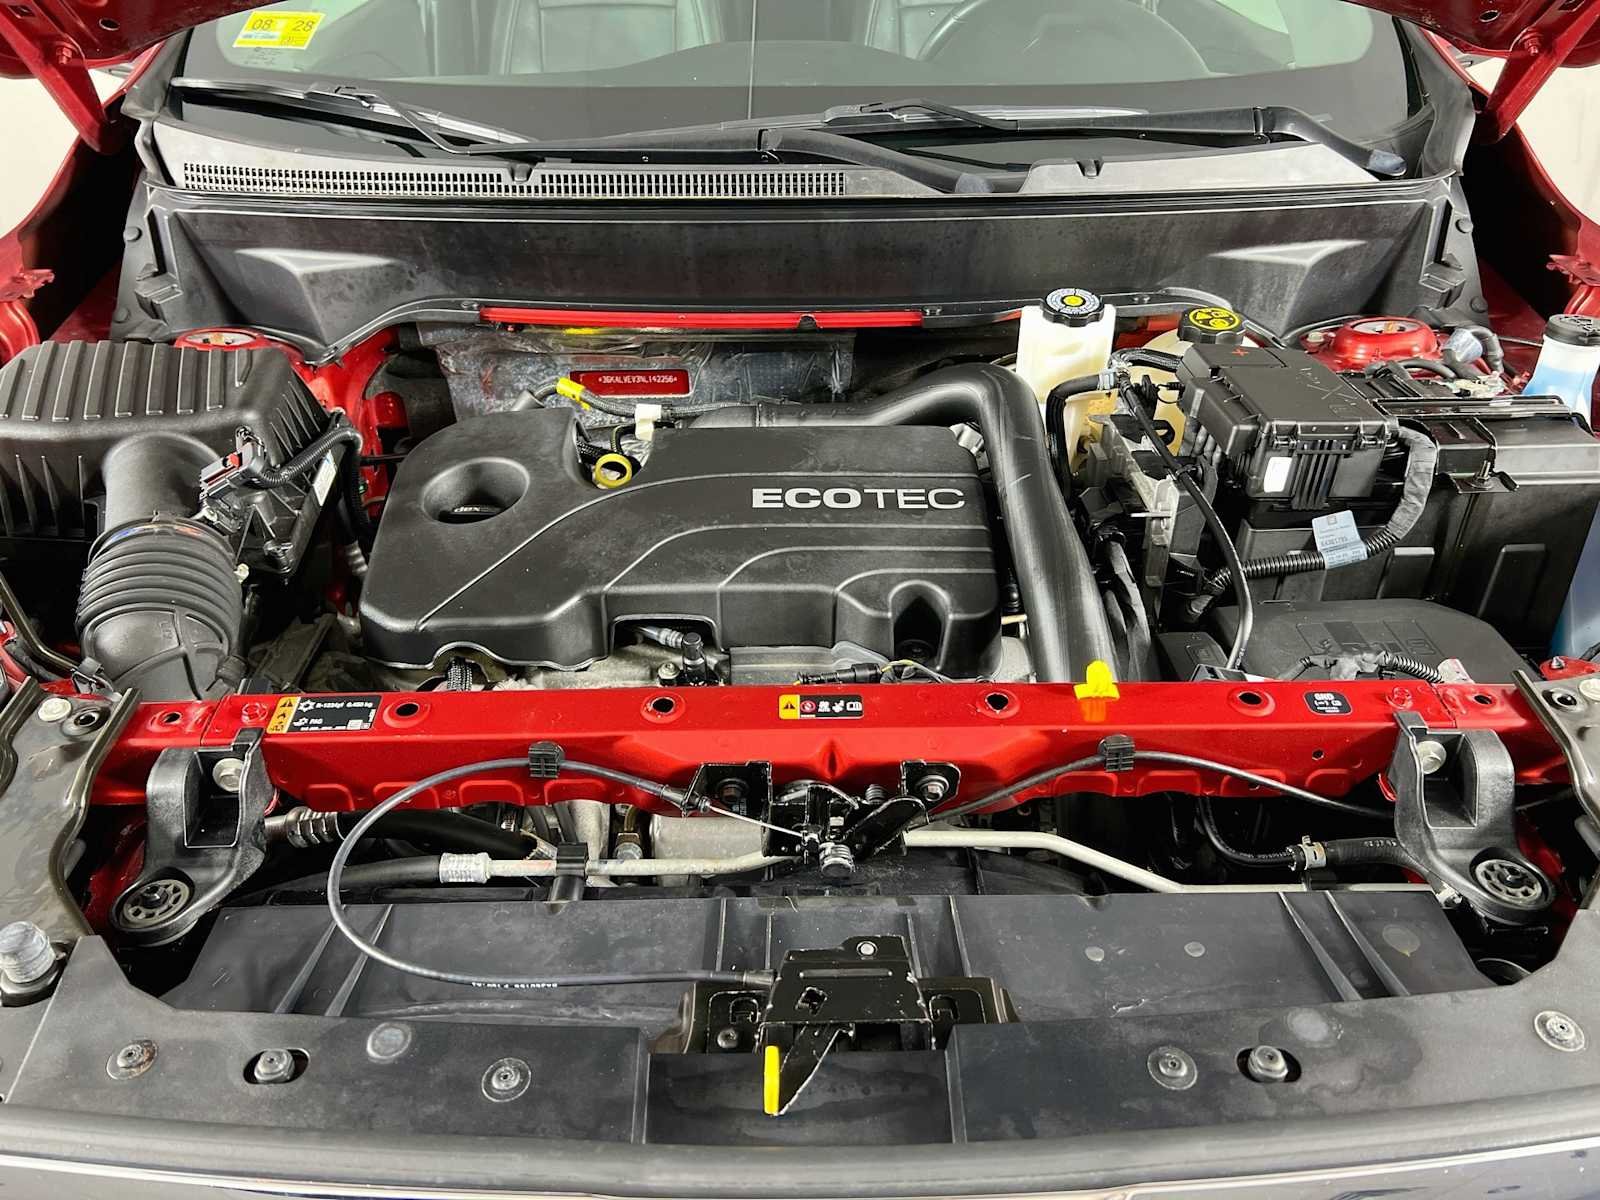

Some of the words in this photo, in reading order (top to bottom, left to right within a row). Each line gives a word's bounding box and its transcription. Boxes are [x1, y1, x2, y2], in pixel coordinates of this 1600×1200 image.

[251, 19, 273, 31] 08
[292, 19, 316, 32] 28
[751, 487, 966, 510] ECOTEC
